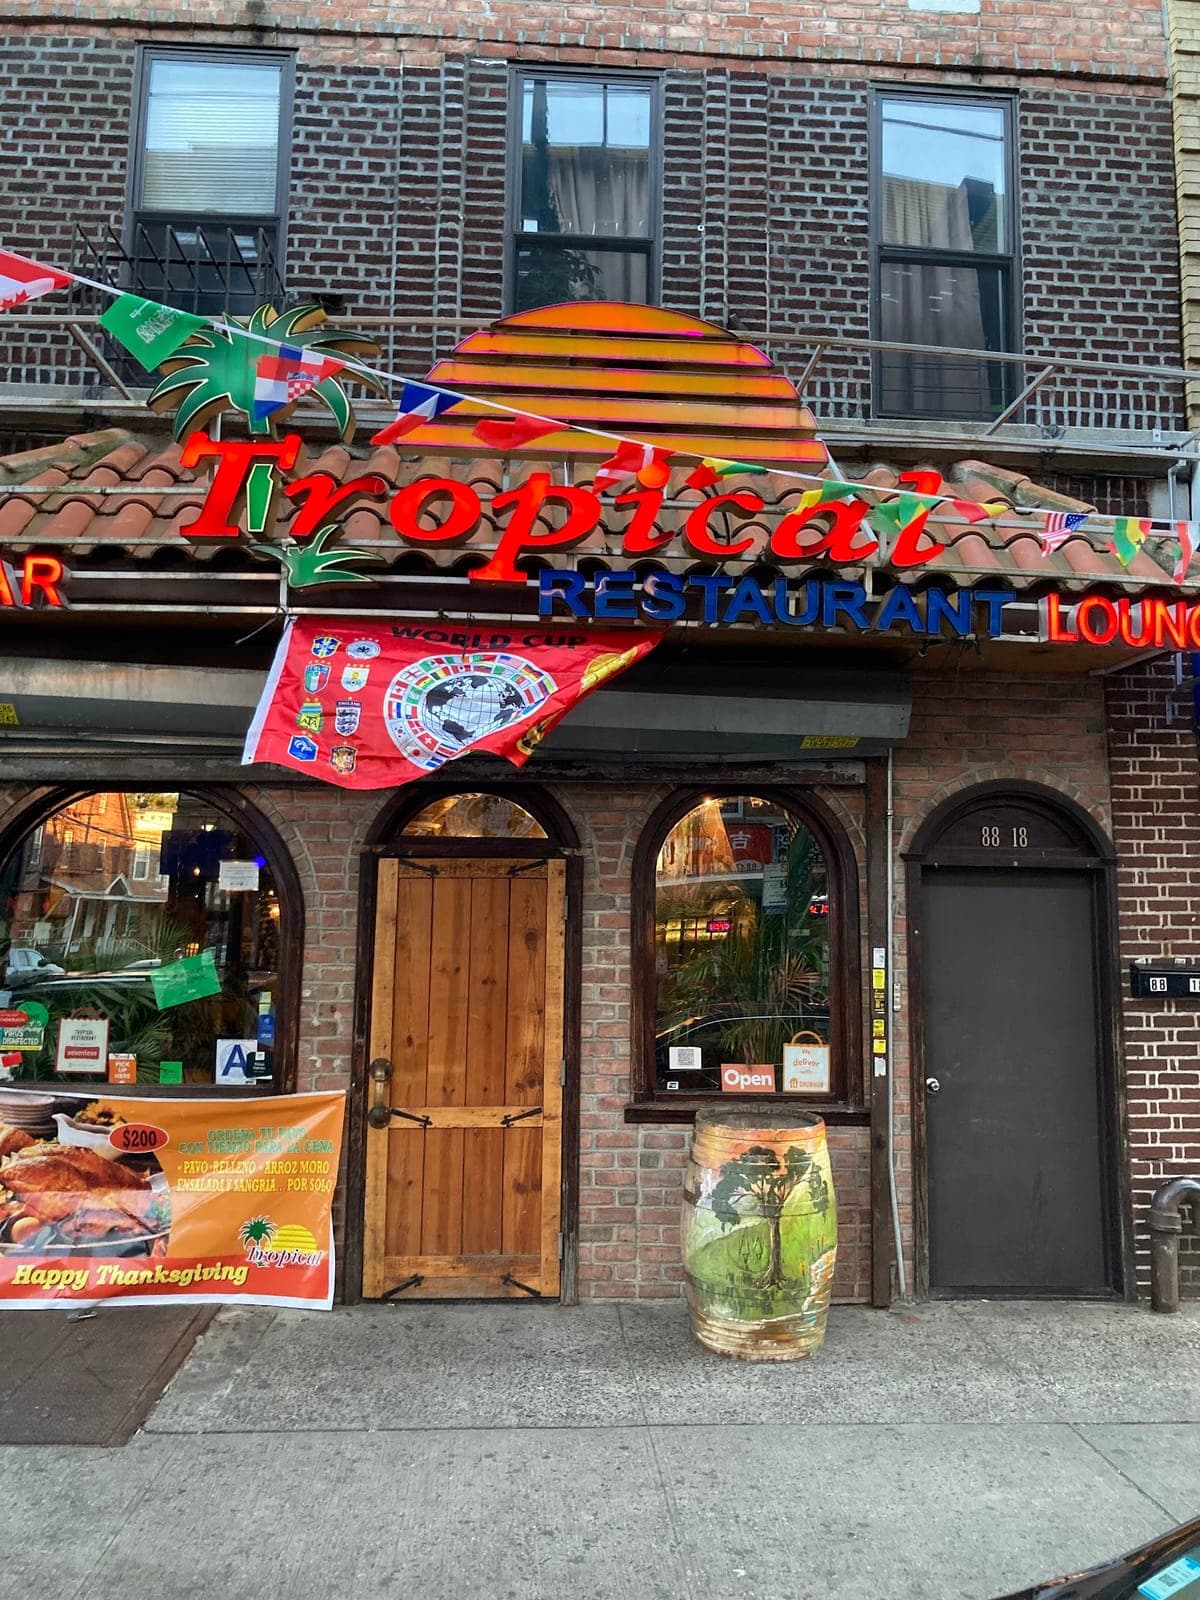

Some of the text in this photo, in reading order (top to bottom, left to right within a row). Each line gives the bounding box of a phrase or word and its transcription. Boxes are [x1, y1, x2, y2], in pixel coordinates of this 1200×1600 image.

[179, 431, 946, 583] Tropical
[538, 569, 1016, 637] RESTAURANT
[391, 626, 588, 649] WORLD CUP
[982, 826, 1028, 847] 88 18
[1151, 978, 1200, 992] 88 1
[66, 1049, 98, 1057] seamless
[221, 1044, 248, 1076] A
[792, 1058, 820, 1067] deliver
[724, 1069, 773, 1089] Open
[123, 1126, 157, 1149] $200
[260, 1127, 273, 1139] TU
[179, 1142, 203, 1154] CON
[287, 1141, 300, 1153] LA
[183, 1160, 330, 1174] PAVO RELLENO ARROZ MORO
[176, 1178, 224, 1192] ENSALADA
[287, 1178, 307, 1191] POR
[310, 1178, 333, 1194] SOLO
[246, 1245, 325, 1268] Tropical
[12, 1262, 249, 1291] Happy Thanksgiving
